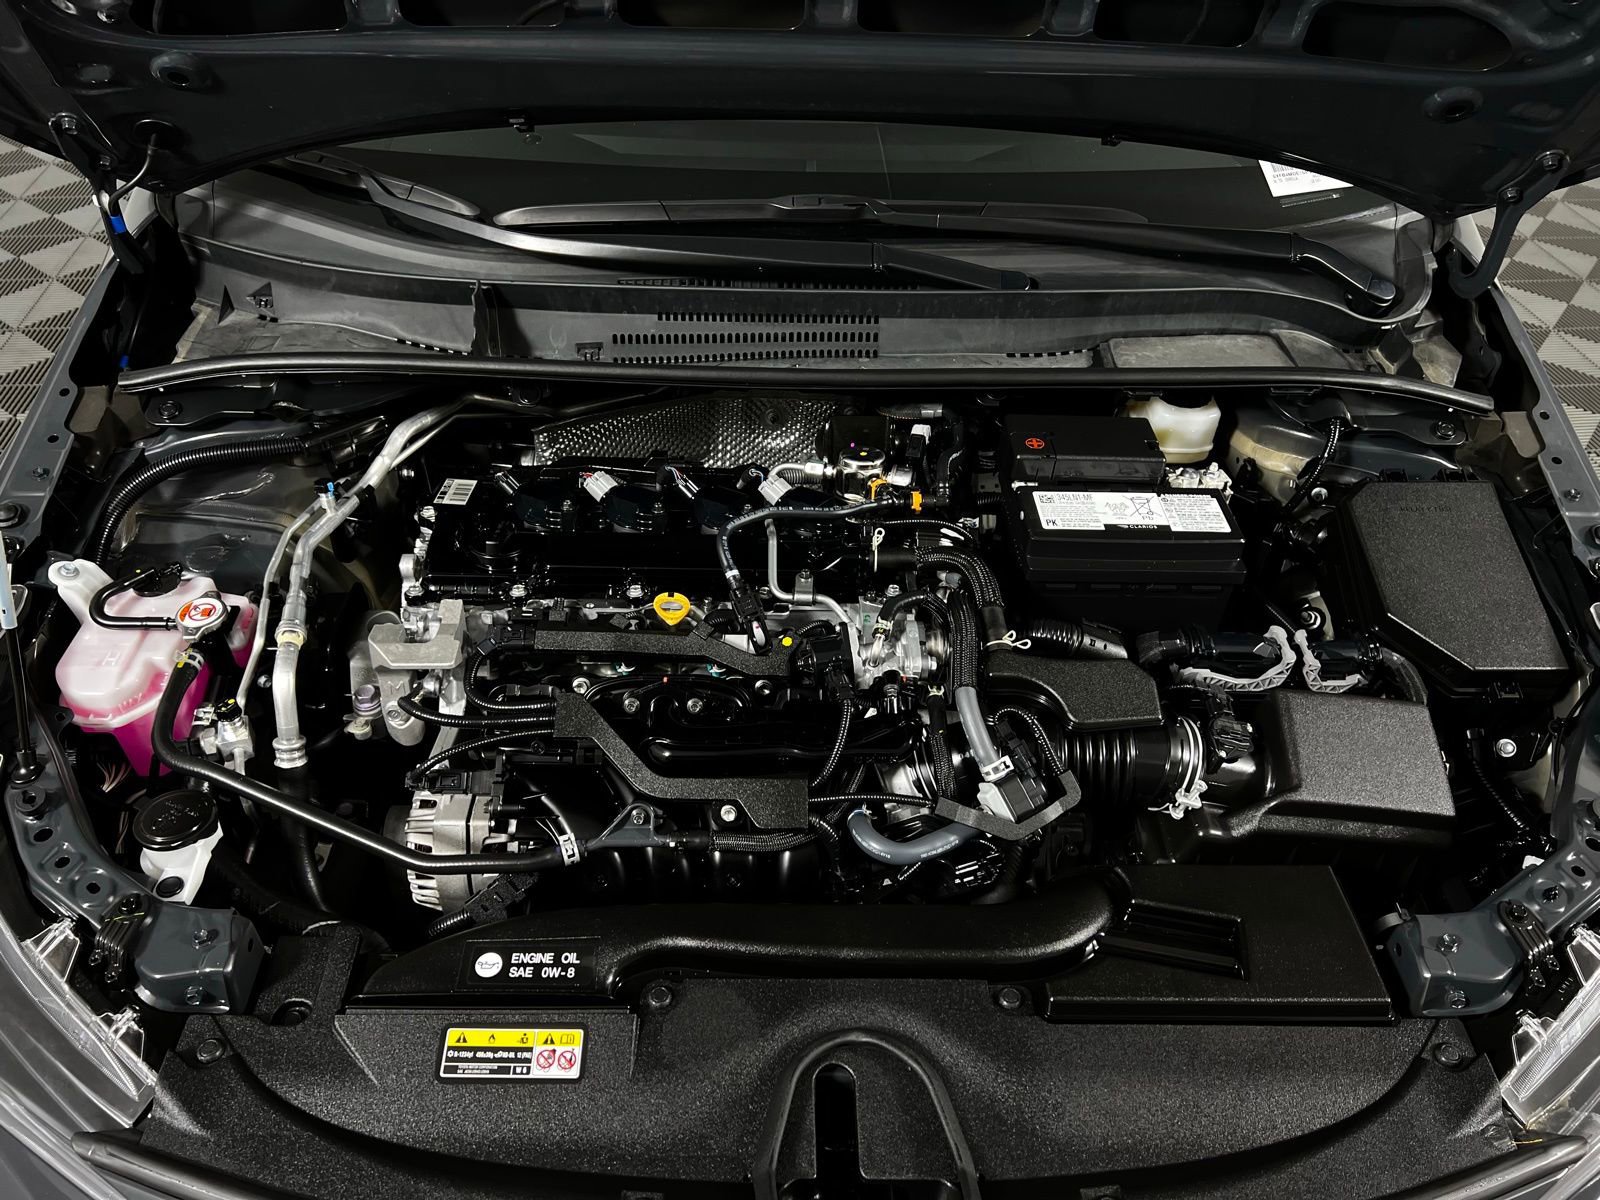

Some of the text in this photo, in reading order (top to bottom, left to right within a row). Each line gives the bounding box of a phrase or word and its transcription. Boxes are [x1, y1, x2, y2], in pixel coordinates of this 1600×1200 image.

[1045, 519, 1059, 527] PK
[511, 952, 581, 964] ENGINE OIL
[508, 966, 576, 978] SAE 0W-8
